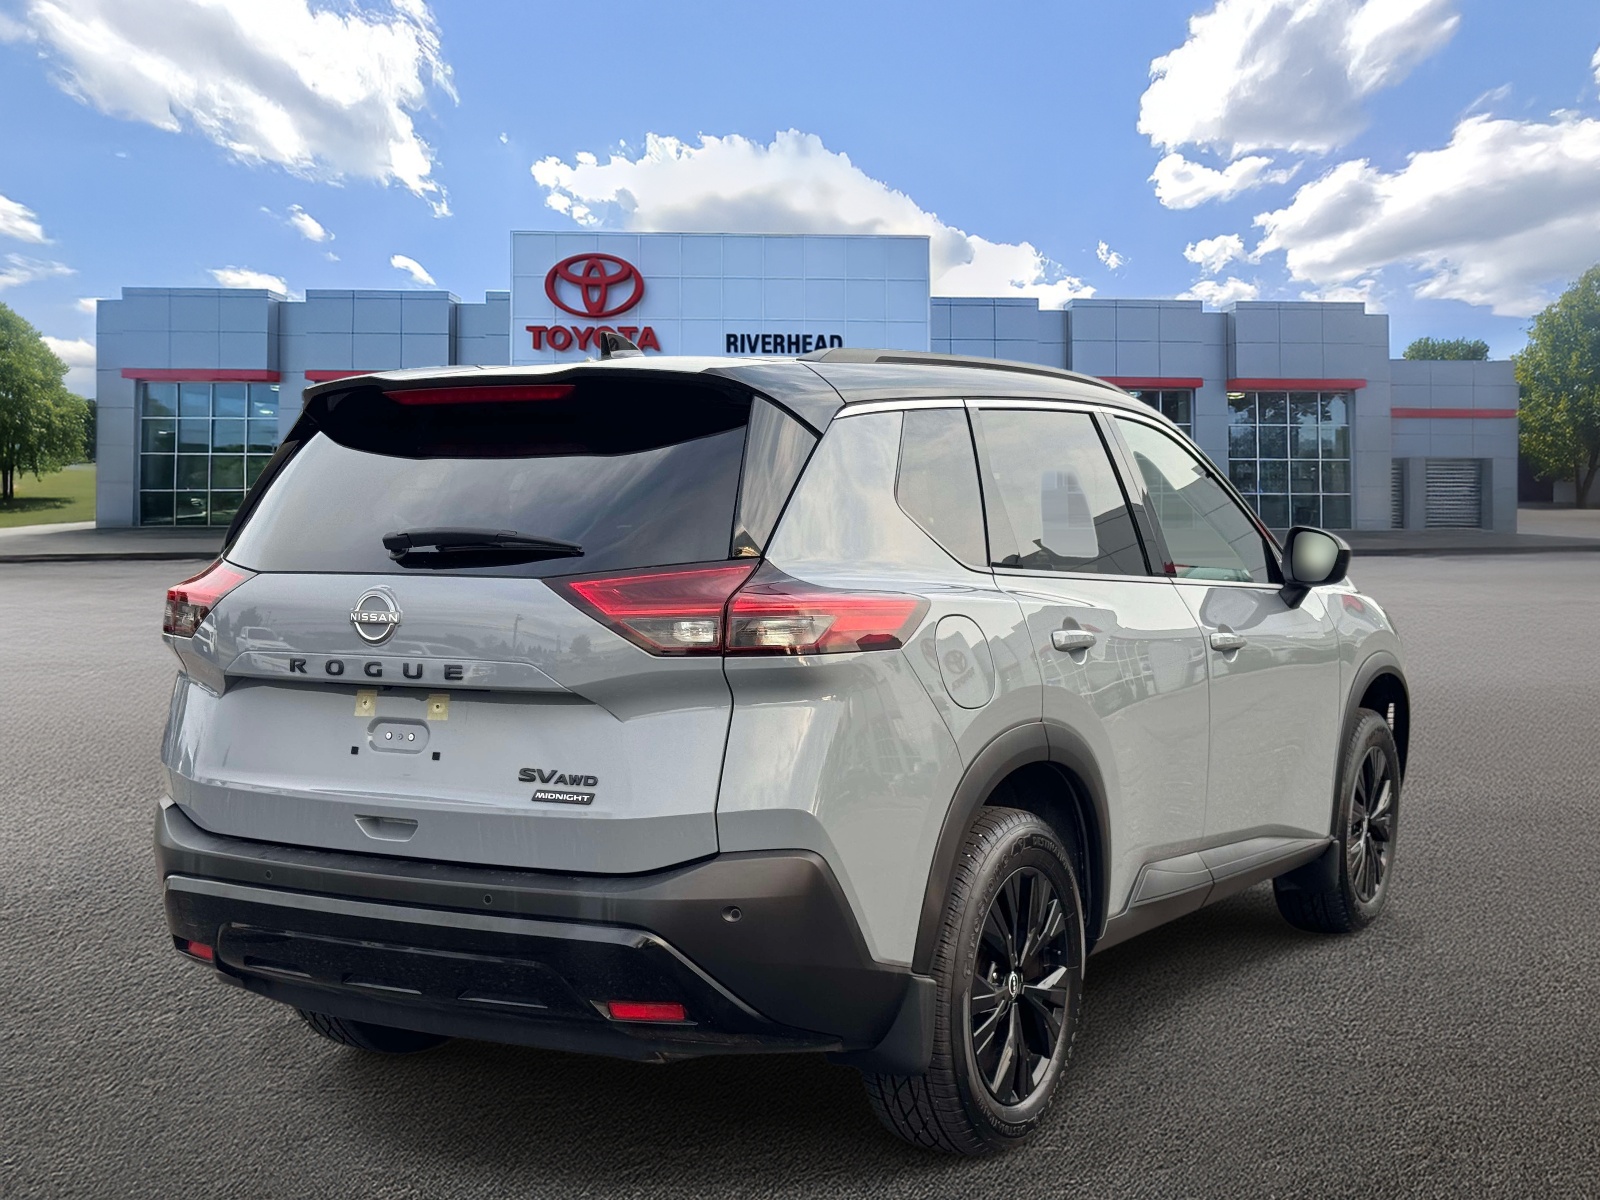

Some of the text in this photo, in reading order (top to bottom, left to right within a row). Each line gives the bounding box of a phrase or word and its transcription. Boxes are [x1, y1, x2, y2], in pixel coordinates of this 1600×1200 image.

[725, 333, 844, 354] RIVERHEAD
[350, 612, 398, 623] NISSAN
[289, 657, 464, 681] ROGUE
[534, 792, 591, 802] MIDNIGHT
